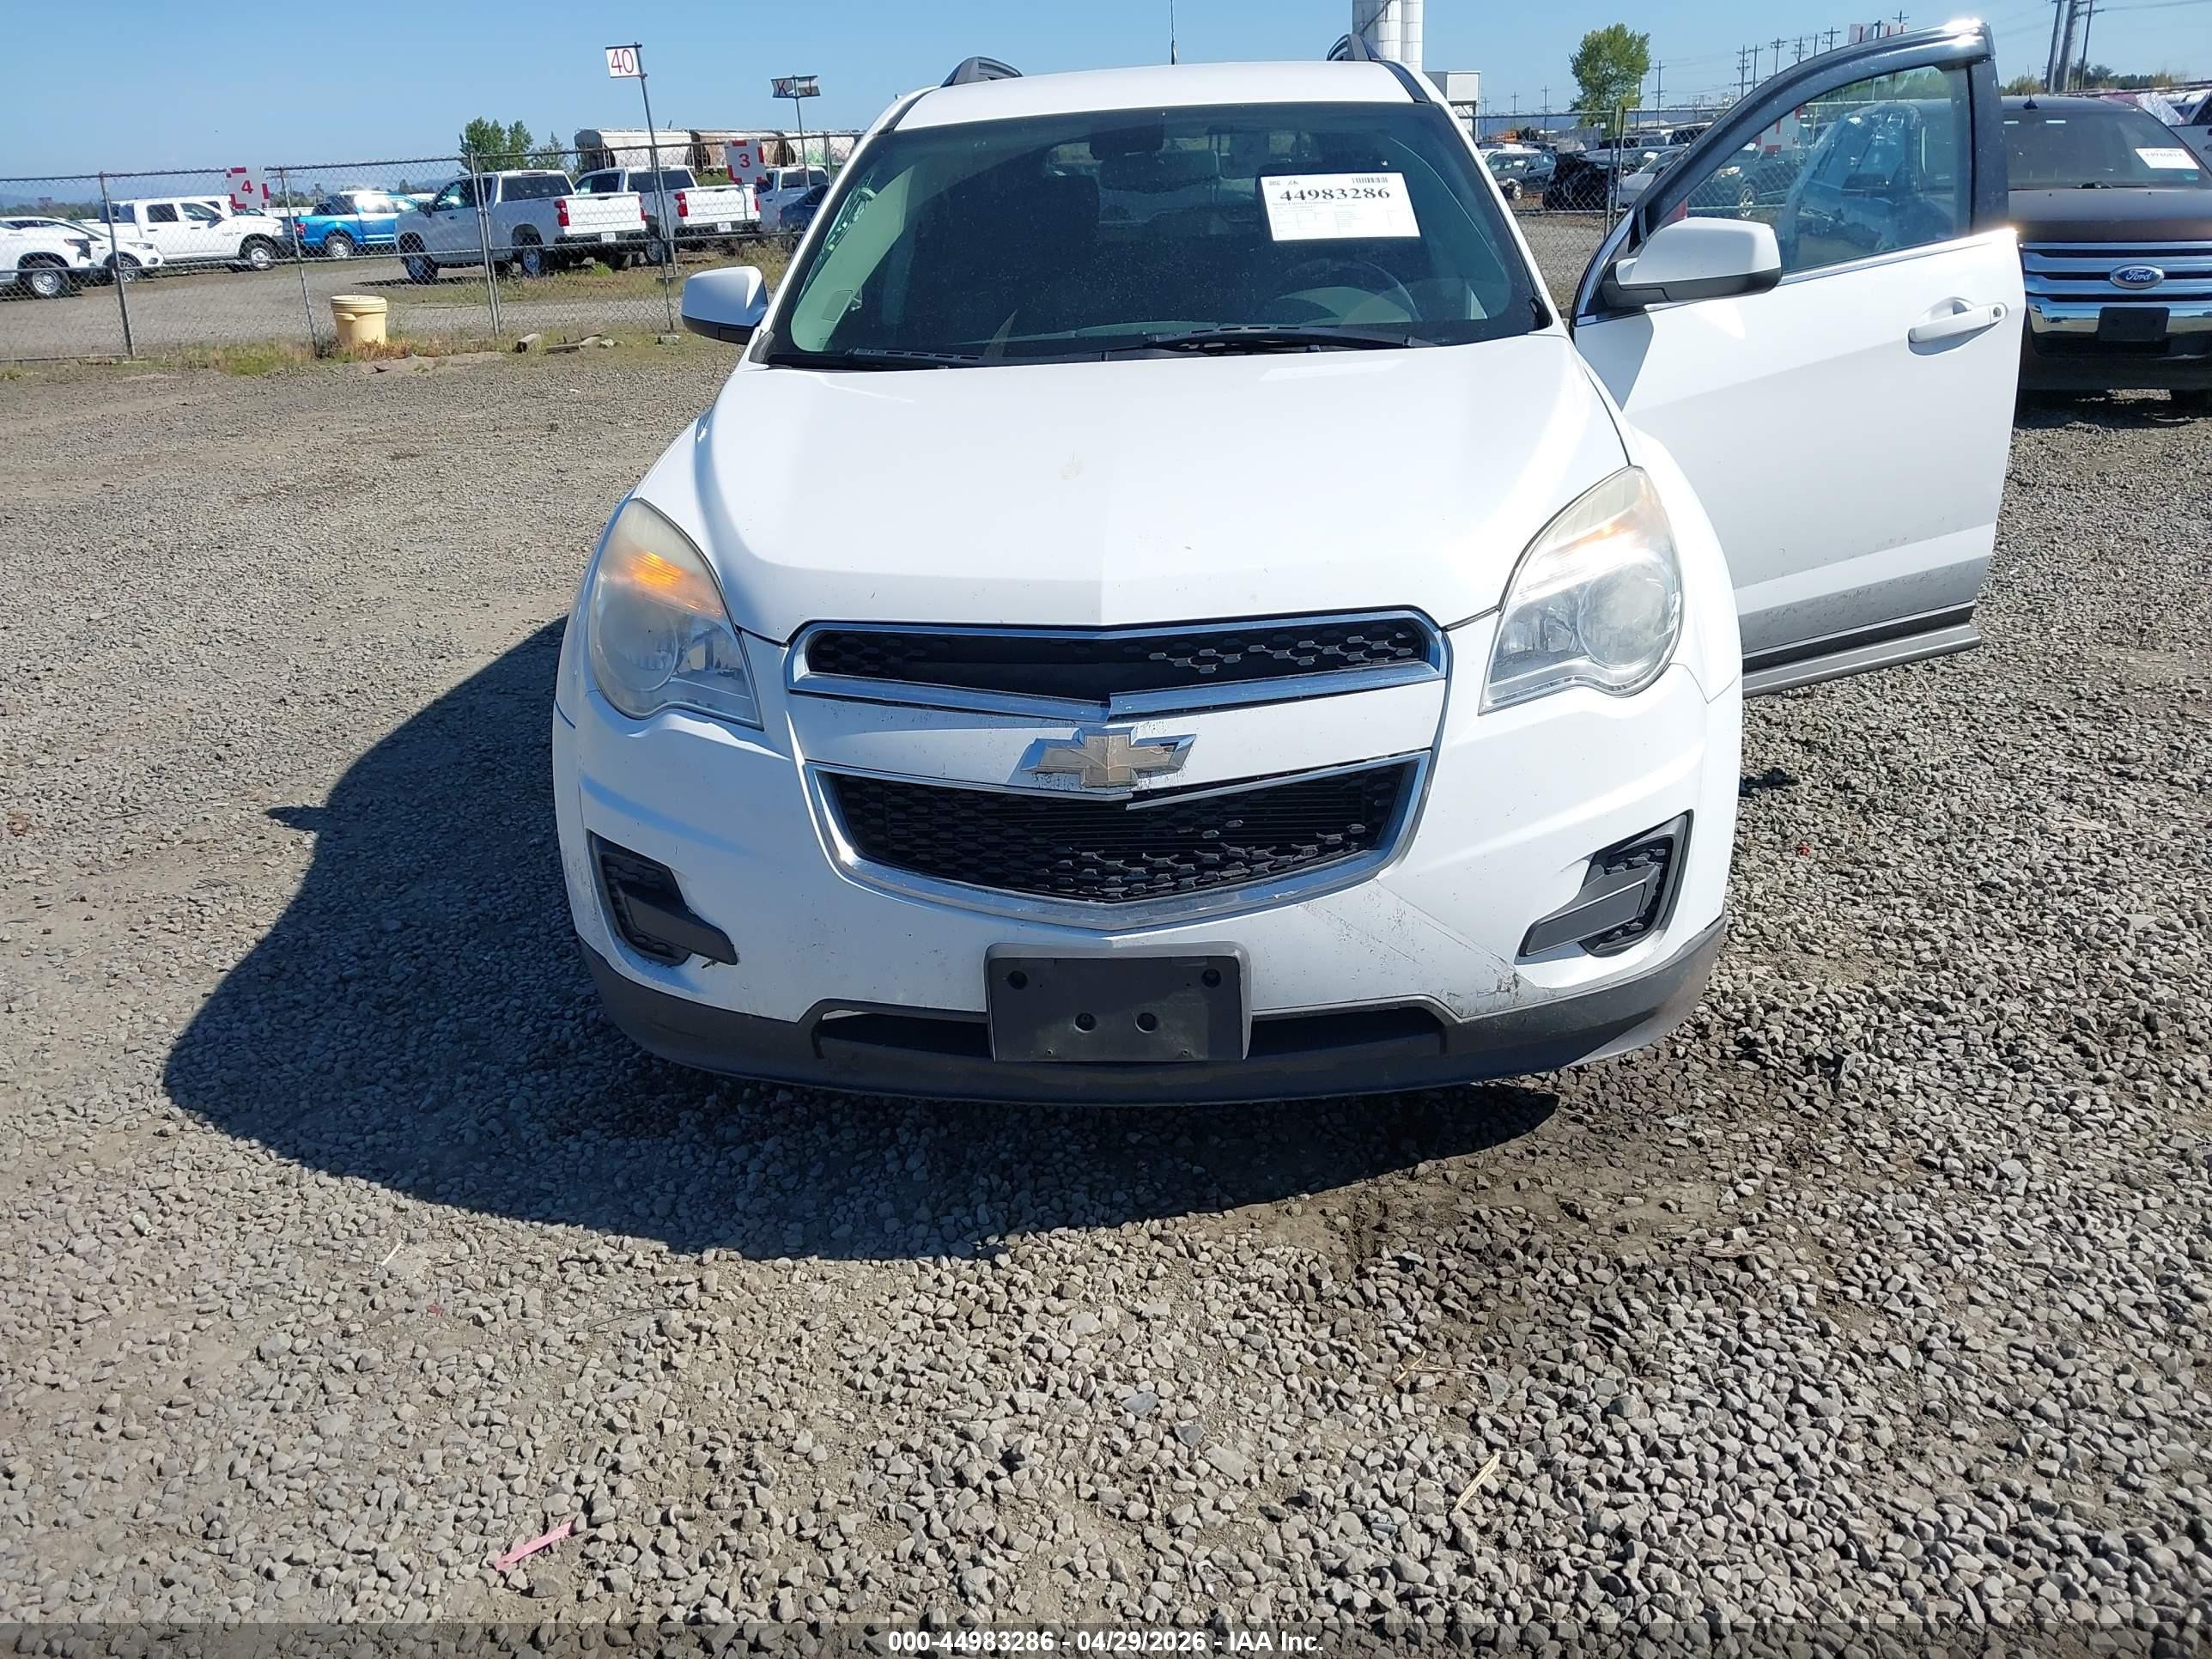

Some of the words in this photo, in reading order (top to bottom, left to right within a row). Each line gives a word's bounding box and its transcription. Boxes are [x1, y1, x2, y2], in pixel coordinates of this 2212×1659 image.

[611, 49, 634, 74] 40
[775, 81, 788, 97] K
[805, 77, 812, 95] J
[738, 153, 750, 168] 3
[241, 179, 253, 194] 4
[1279, 186, 1390, 201] 44983286
[2125, 269, 2153, 281] Ford
